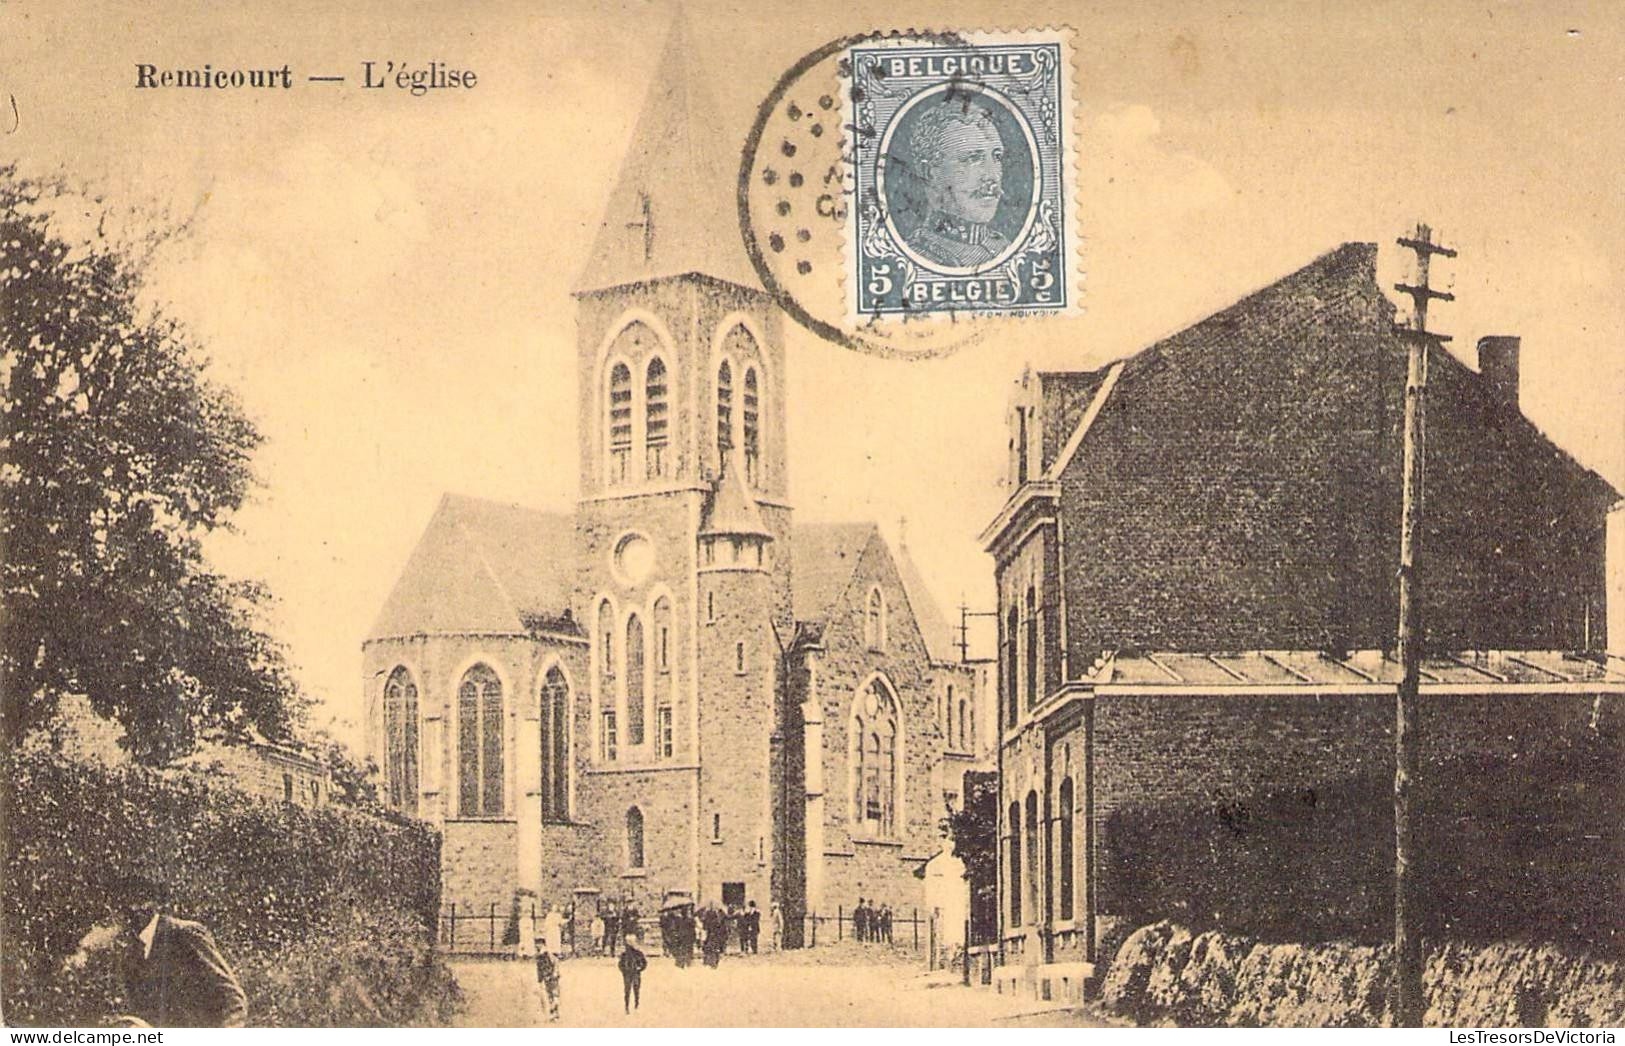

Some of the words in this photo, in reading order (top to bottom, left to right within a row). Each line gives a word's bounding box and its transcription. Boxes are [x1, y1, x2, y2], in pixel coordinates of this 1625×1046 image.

[135, 63, 293, 90] Remicourt
[361, 61, 479, 97] L'église
[889, 53, 1023, 78] BELGIQUE
[868, 264, 893, 295] 5
[1030, 257, 1054, 291] 5
[913, 279, 1010, 303] BELGIE
